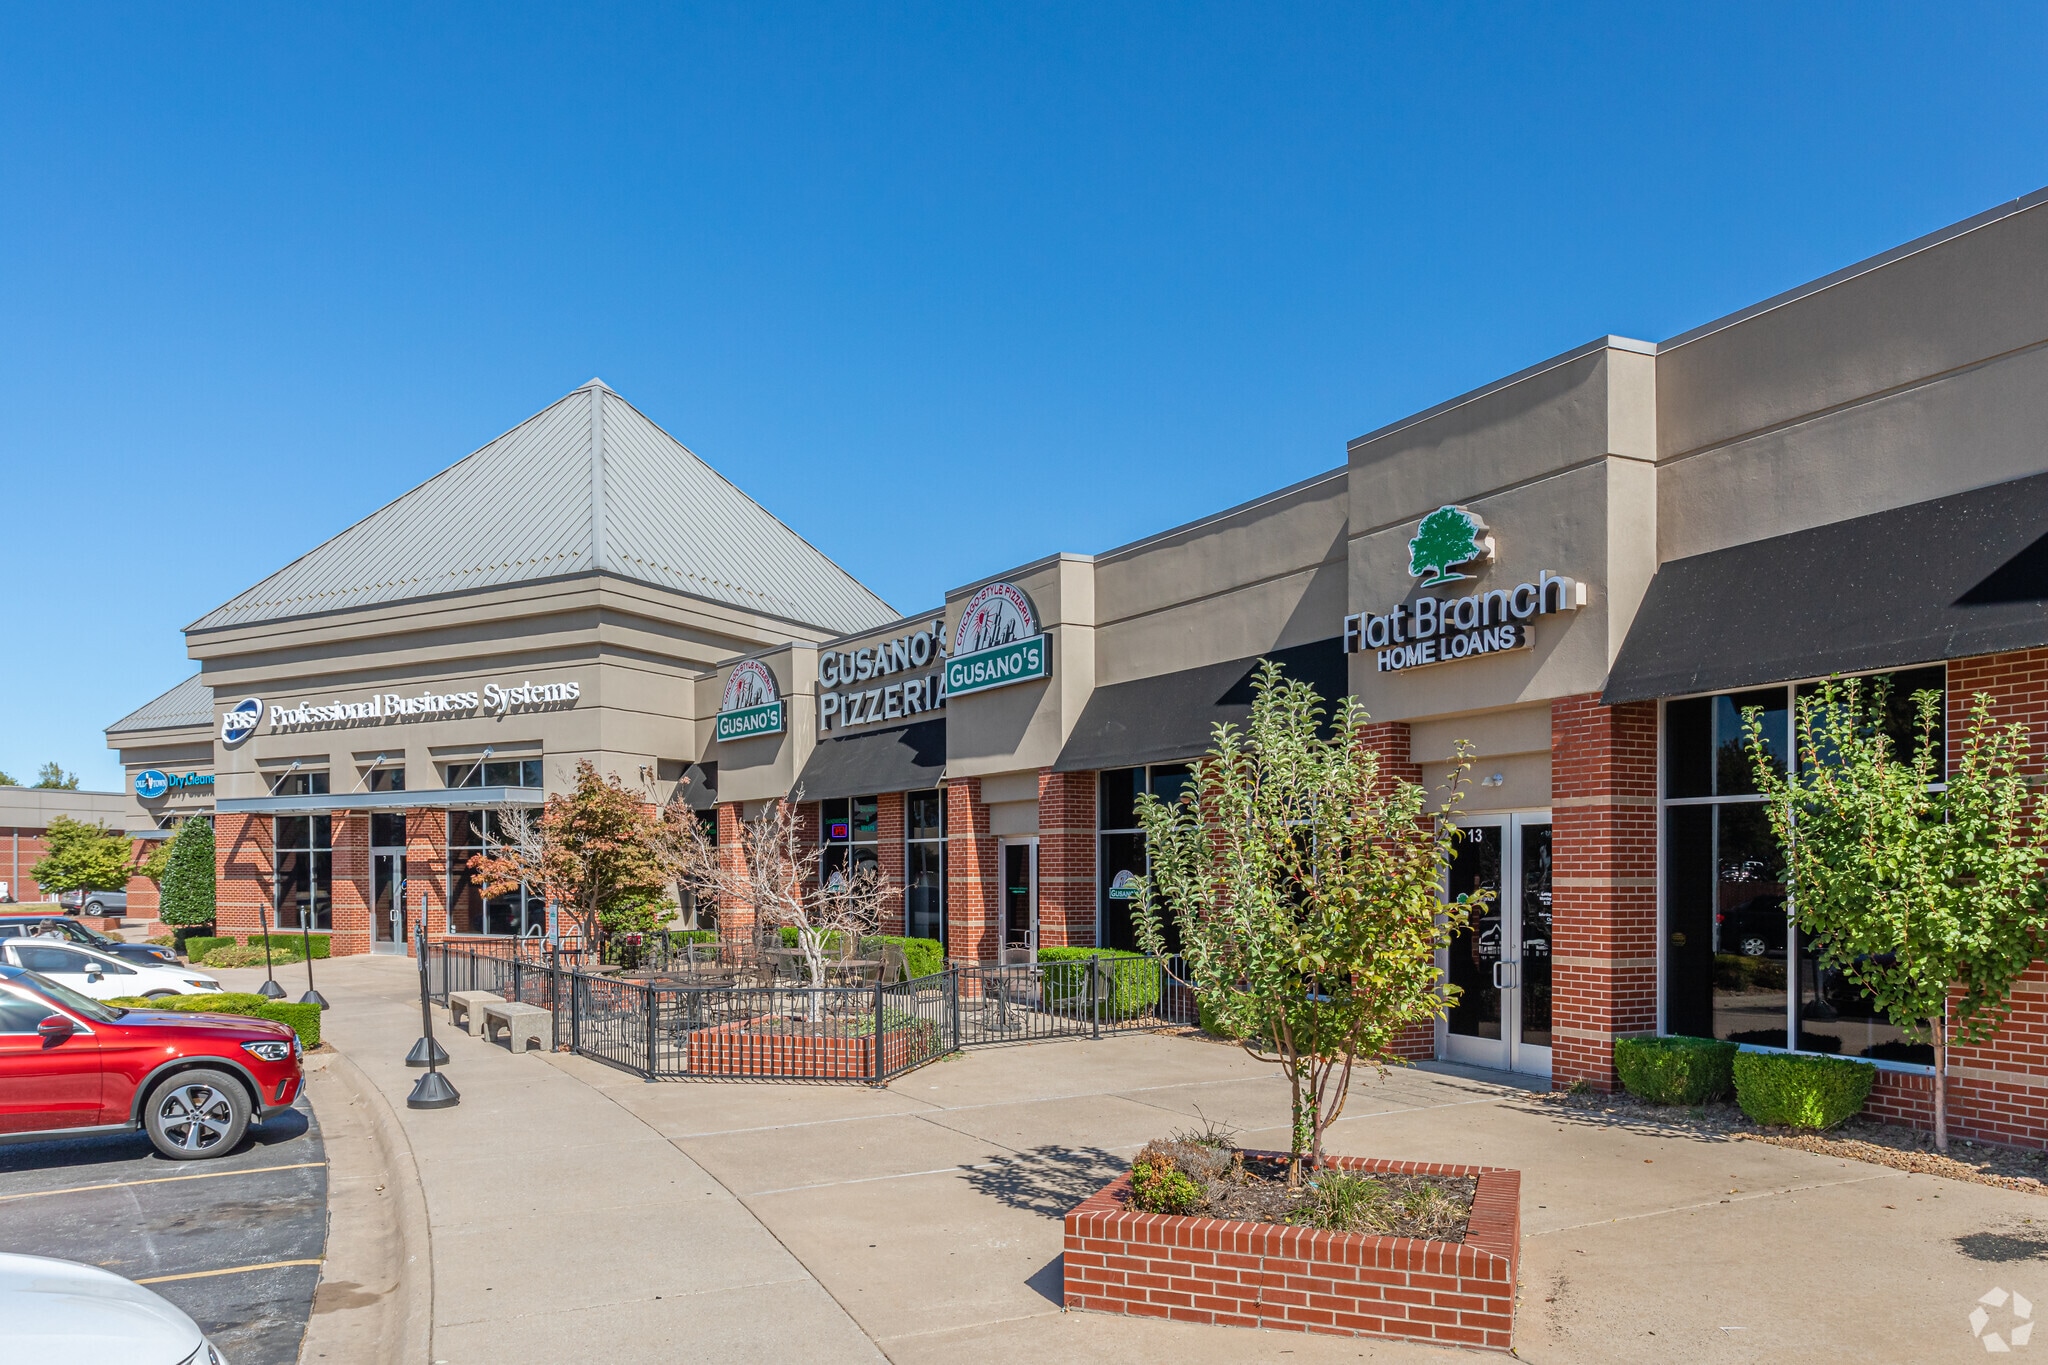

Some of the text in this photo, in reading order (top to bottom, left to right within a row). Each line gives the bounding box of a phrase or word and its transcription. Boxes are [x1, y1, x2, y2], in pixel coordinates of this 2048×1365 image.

[957, 584, 1031, 647] CHICAGO-STYLE PIZZERIA
[1344, 569, 1567, 653] Flat Branch
[950, 646, 1040, 688] GUSANO'S
[1377, 625, 1517, 672] HOME LOANS
[269, 680, 580, 727] Professional Business Systems
[719, 708, 778, 735] GUSANO'S
[820, 672, 946, 731] PIZZERIA
[169, 774, 185, 789] Dry
[1467, 828, 1483, 843] 13
